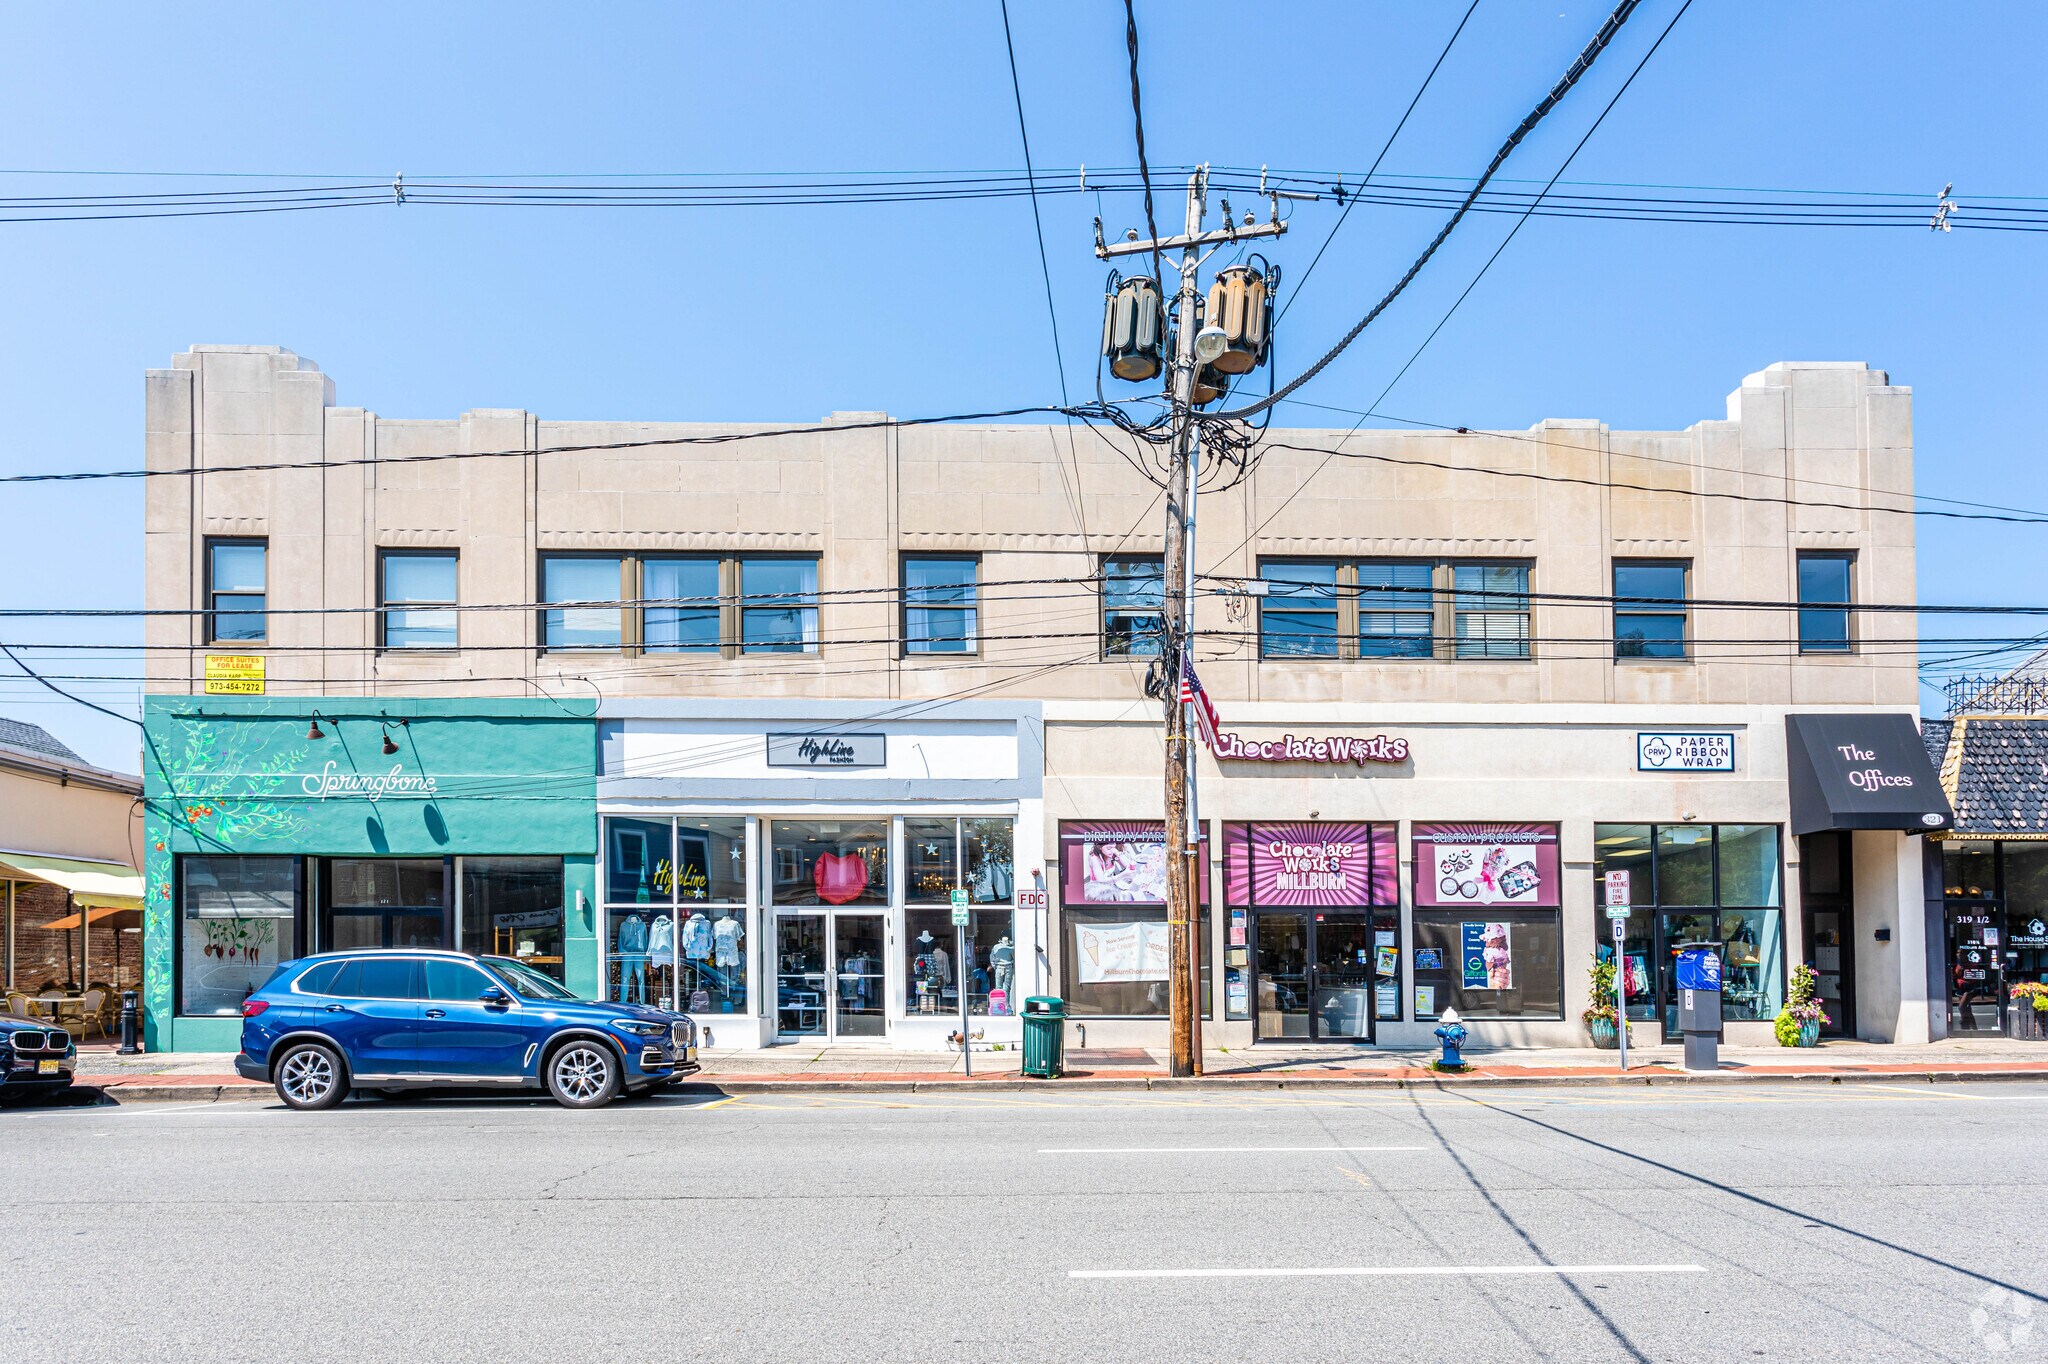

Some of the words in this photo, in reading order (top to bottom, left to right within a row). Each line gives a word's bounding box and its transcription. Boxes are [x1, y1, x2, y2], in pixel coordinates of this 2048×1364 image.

[210, 682, 260, 691] 973-454-7272
[1680, 737, 1724, 747] PAPER
[798, 737, 855, 764] HighLine
[1676, 747, 1728, 757] RIBBON
[1837, 744, 1876, 761] The
[1682, 758, 1723, 767] WRAP
[302, 760, 437, 802] Springbone
[1849, 769, 1913, 792] Offices
[1924, 815, 1942, 824] 321
[1432, 832, 1477, 843] CUSTOM
[1480, 832, 1541, 844] PRODUCTS
[1269, 840, 1353, 858] Chocolate
[653, 858, 707, 895] HighLine
[1276, 872, 1347, 890] MILLBURN
[1020, 894, 1044, 905] FDC
[1956, 915, 1973, 924] 319
[1976, 915, 1990, 924] 1/2
[1616, 926, 1622, 937] D
